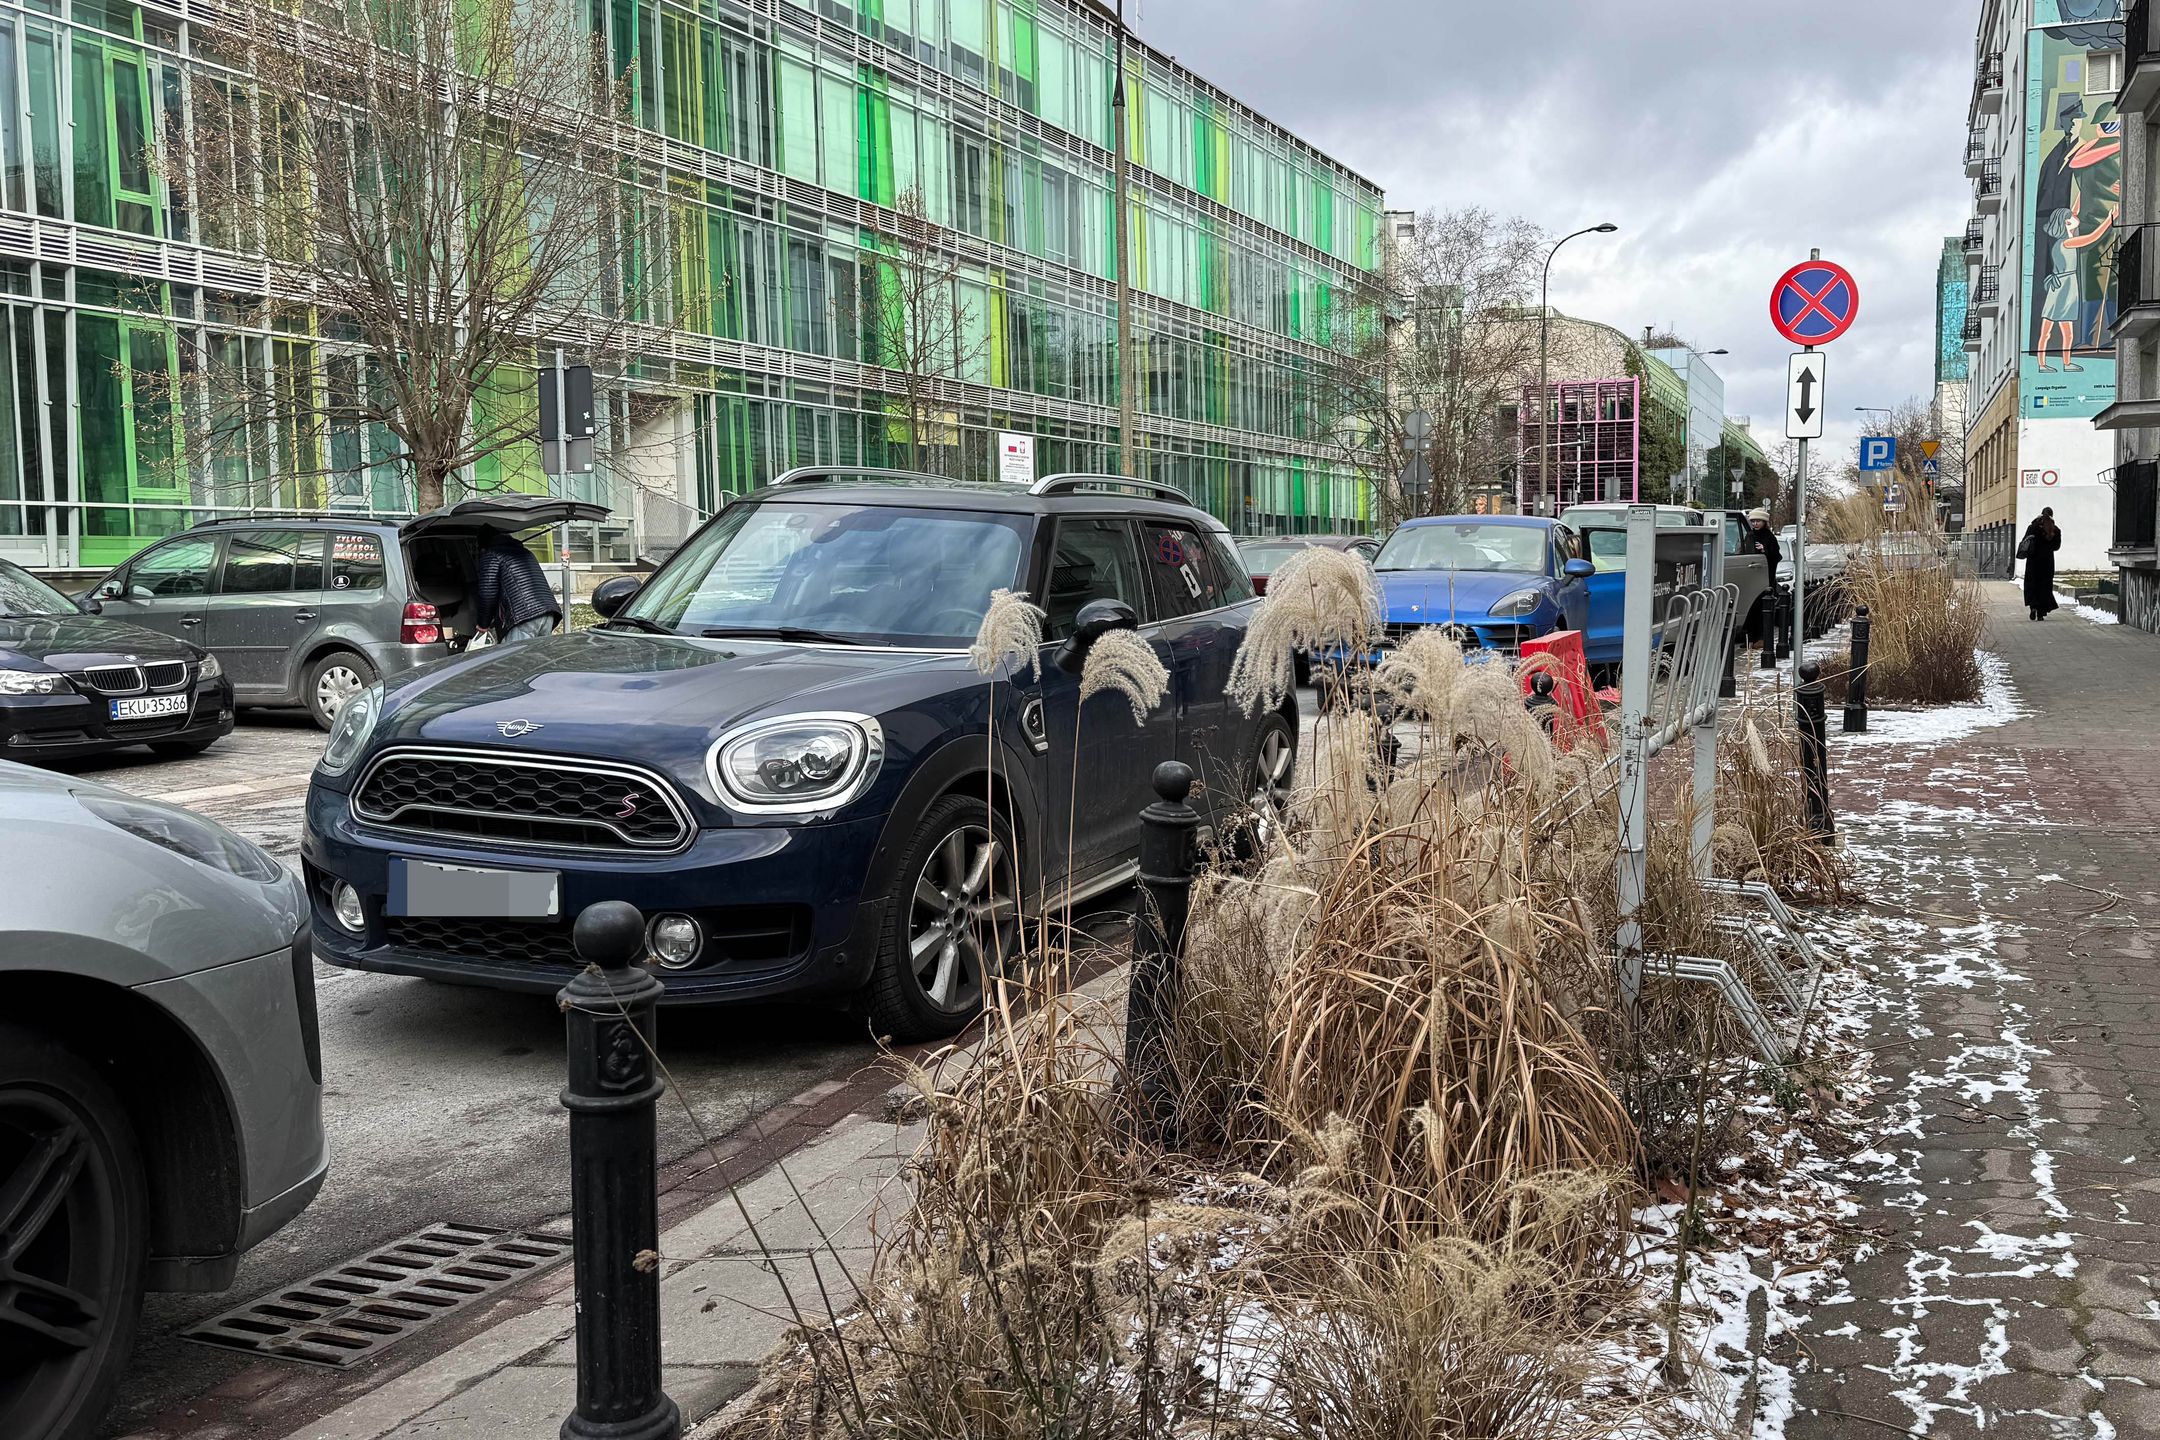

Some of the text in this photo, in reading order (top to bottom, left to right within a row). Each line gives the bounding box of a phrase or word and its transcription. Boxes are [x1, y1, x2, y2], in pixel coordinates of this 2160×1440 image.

[1867, 441, 1888, 467] P
[332, 552, 379, 560] NAWROCKI
[347, 543, 374, 551] KAROL
[119, 696, 186, 715] EKU 35366
[615, 793, 640, 819] S
